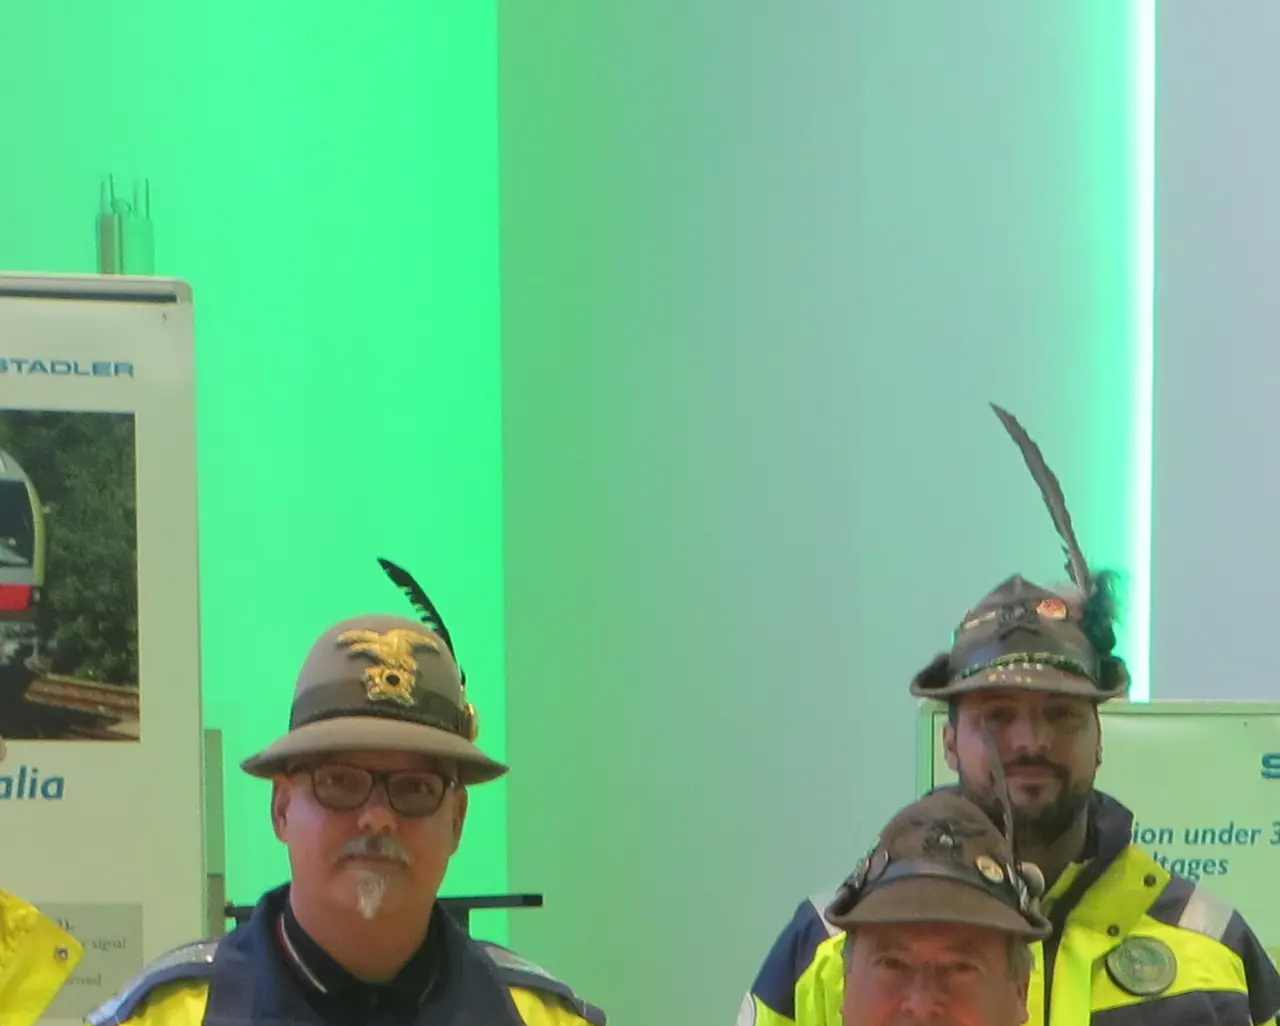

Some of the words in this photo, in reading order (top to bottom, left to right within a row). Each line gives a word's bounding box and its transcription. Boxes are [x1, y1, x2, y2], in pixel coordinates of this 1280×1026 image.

[1131, 821, 1174, 845] ion
[1183, 820, 1262, 845] under
[1152, 850, 1229, 881] ltages
